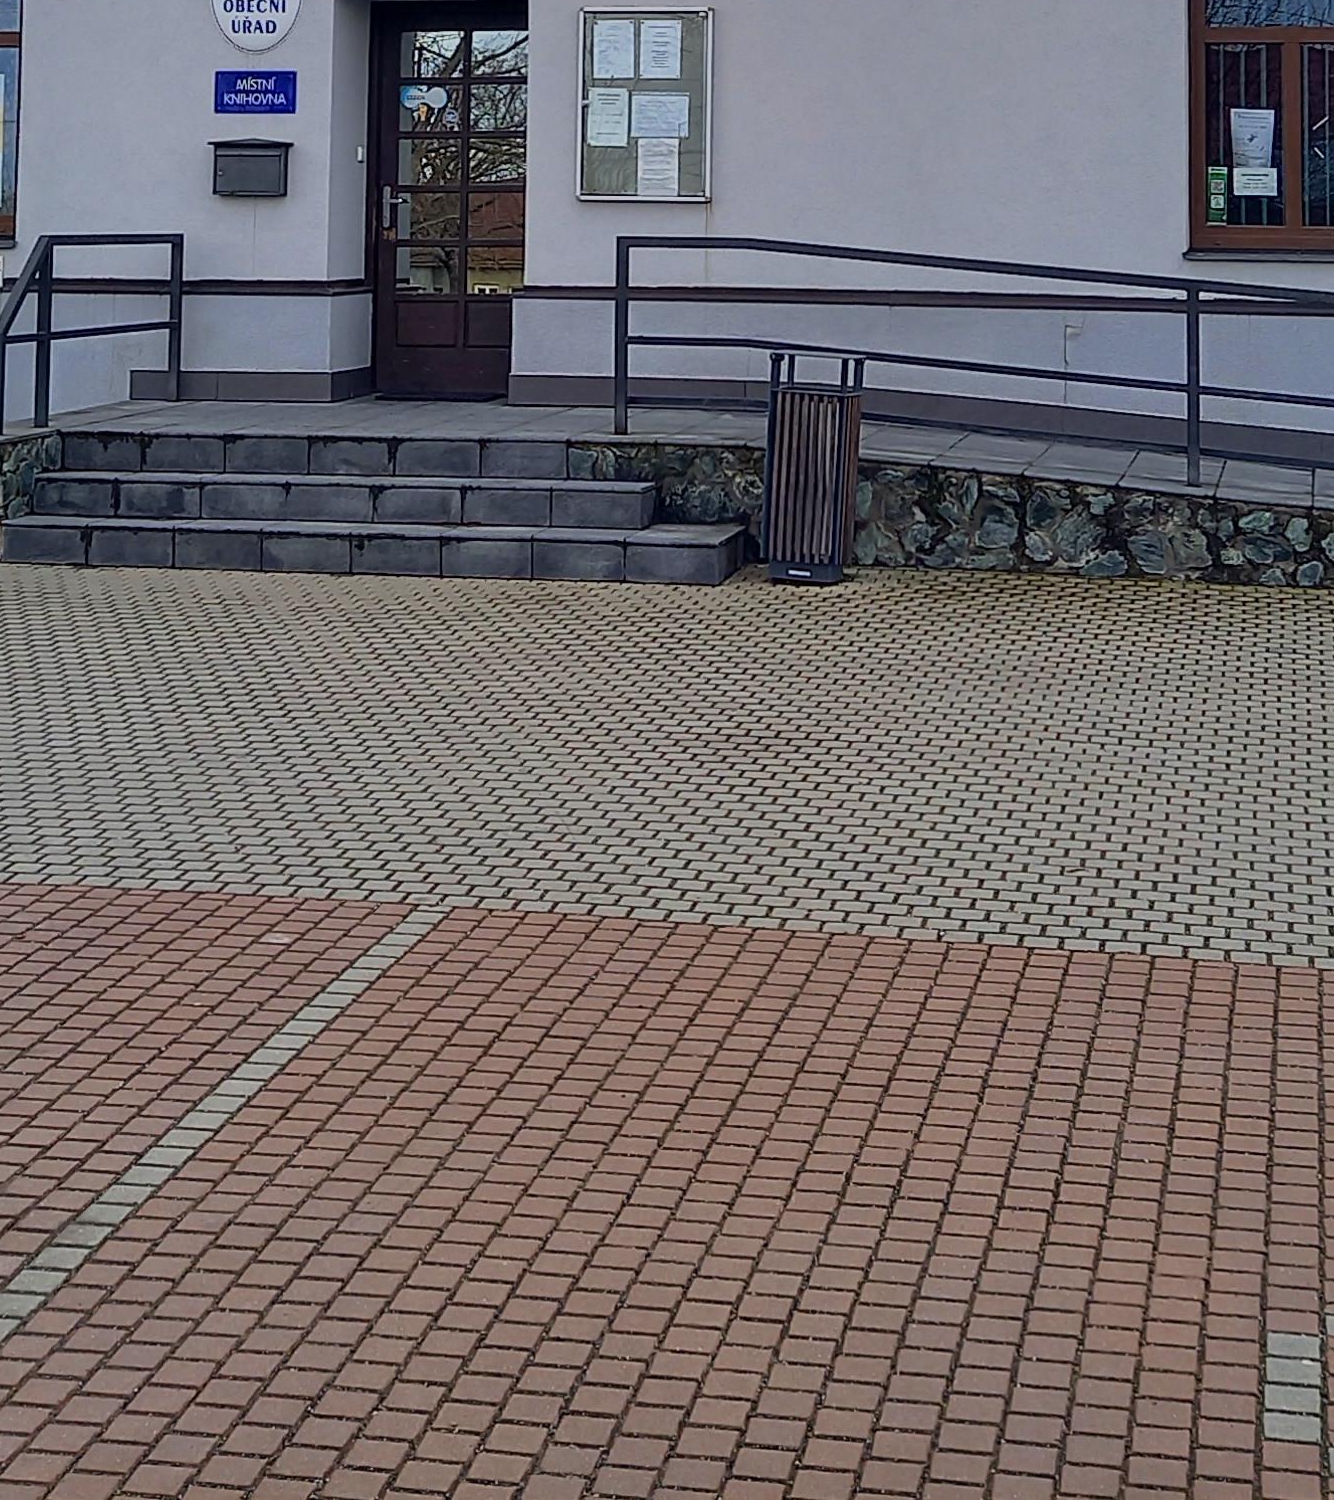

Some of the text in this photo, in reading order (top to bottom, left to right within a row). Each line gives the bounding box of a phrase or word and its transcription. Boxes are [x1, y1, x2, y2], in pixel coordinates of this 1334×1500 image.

[231, 15, 277, 34] ÚŘAD
[235, 76, 276, 91] MÍSTNÍ
[223, 93, 286, 105] KNIHOVNA
